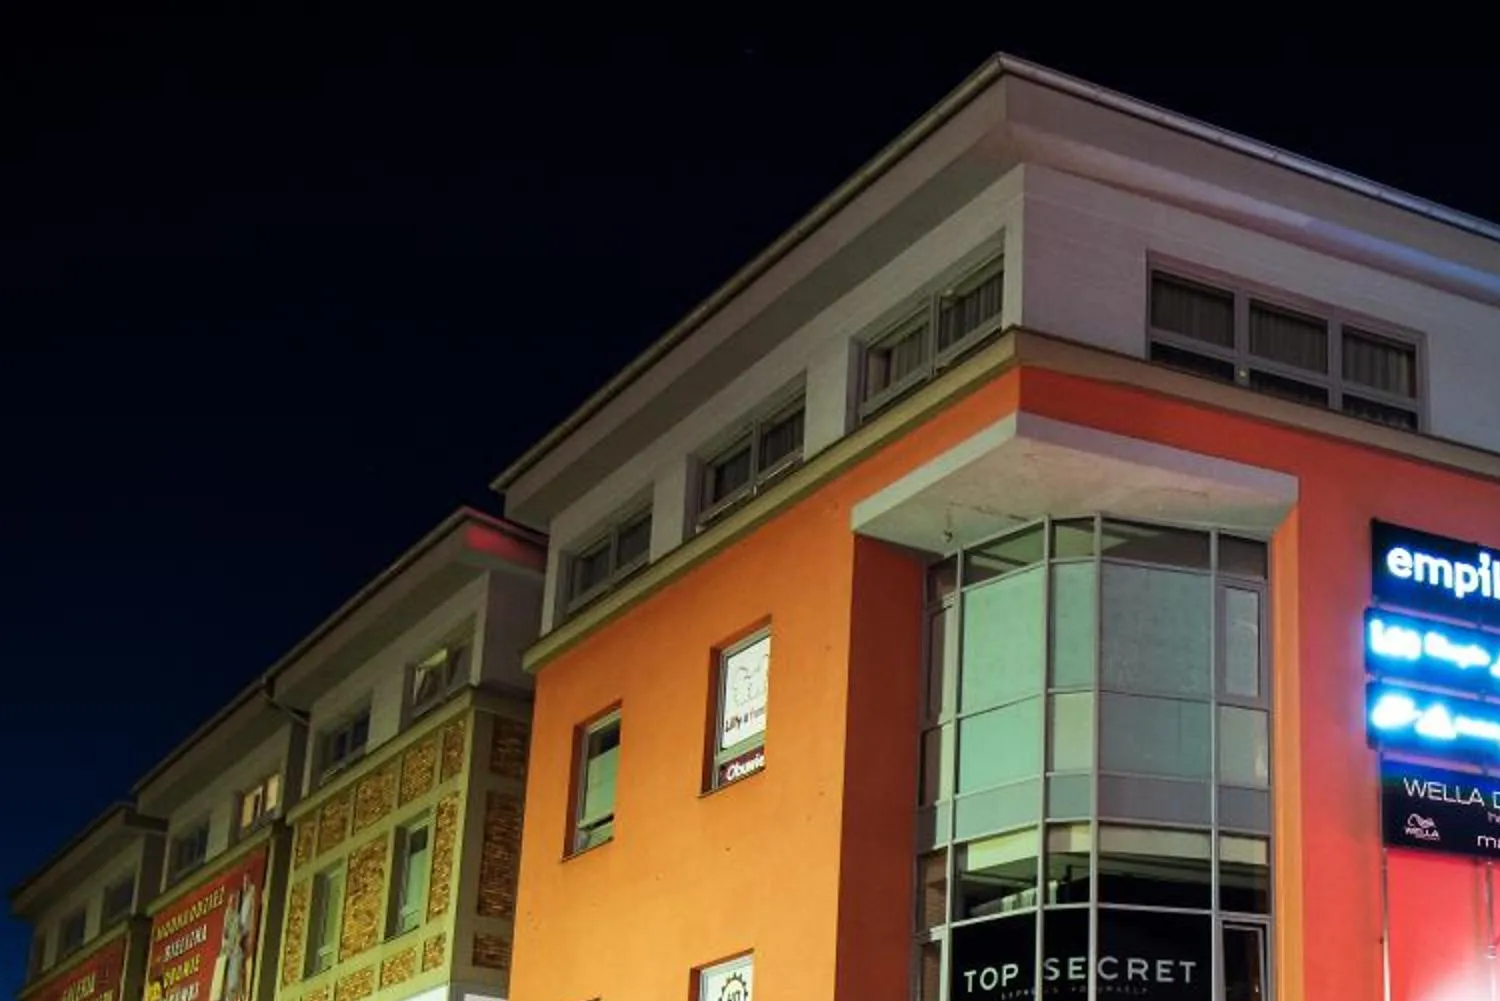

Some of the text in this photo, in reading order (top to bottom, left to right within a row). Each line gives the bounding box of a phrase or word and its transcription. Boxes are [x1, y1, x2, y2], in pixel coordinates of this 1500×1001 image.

[1403, 777, 1485, 807] WELLA
[963, 955, 1197, 993] TOP SECRET
